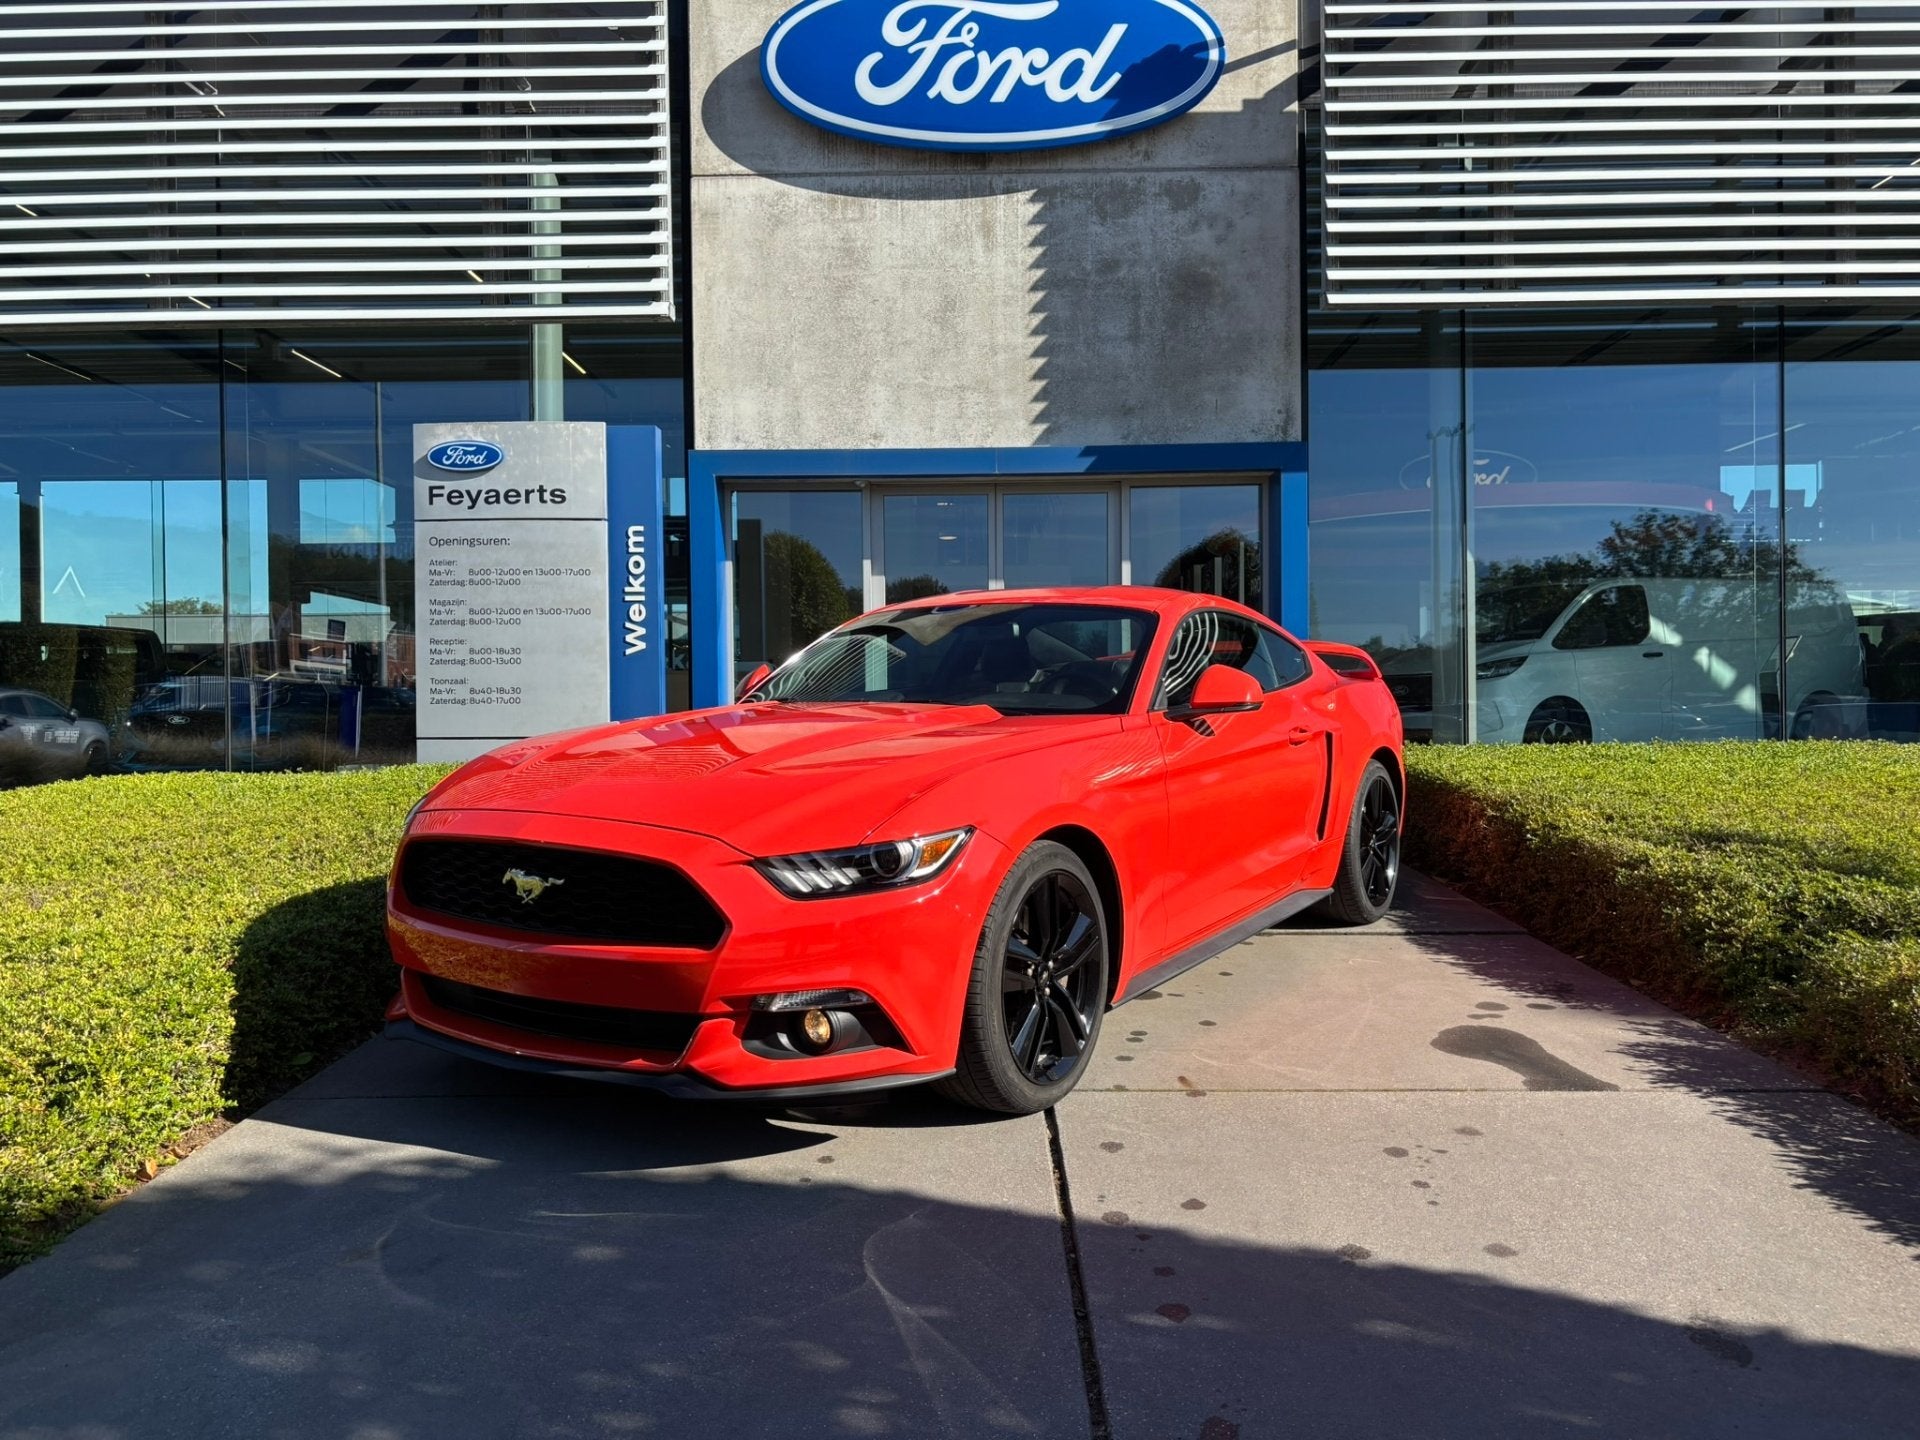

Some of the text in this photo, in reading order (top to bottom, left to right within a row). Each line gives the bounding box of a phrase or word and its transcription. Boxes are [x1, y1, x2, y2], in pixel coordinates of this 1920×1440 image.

[854, 0, 1129, 106] Ford
[442, 445, 487, 465] Ford
[428, 485, 567, 510] Feyaerts
[428, 536, 511, 548] Openingsuren:
[428, 559, 458, 567] Atelier:
[428, 569, 456, 577] Ma-Vr:
[428, 578, 468, 587] Zaterdag:
[624, 525, 647, 656] Welkom
[429, 598, 467, 607] Magazijn:
[429, 608, 456, 616] Ma-Vr:
[429, 618, 468, 627] Zaterdag:
[429, 637, 468, 647] Receptie:
[429, 648, 456, 656] Ma-Vr:
[429, 657, 468, 666] Zaterdag:
[430, 677, 469, 685] Toonzaal:
[429, 687, 456, 695] Ma-Vr:
[429, 697, 468, 706] Zaterdag:
